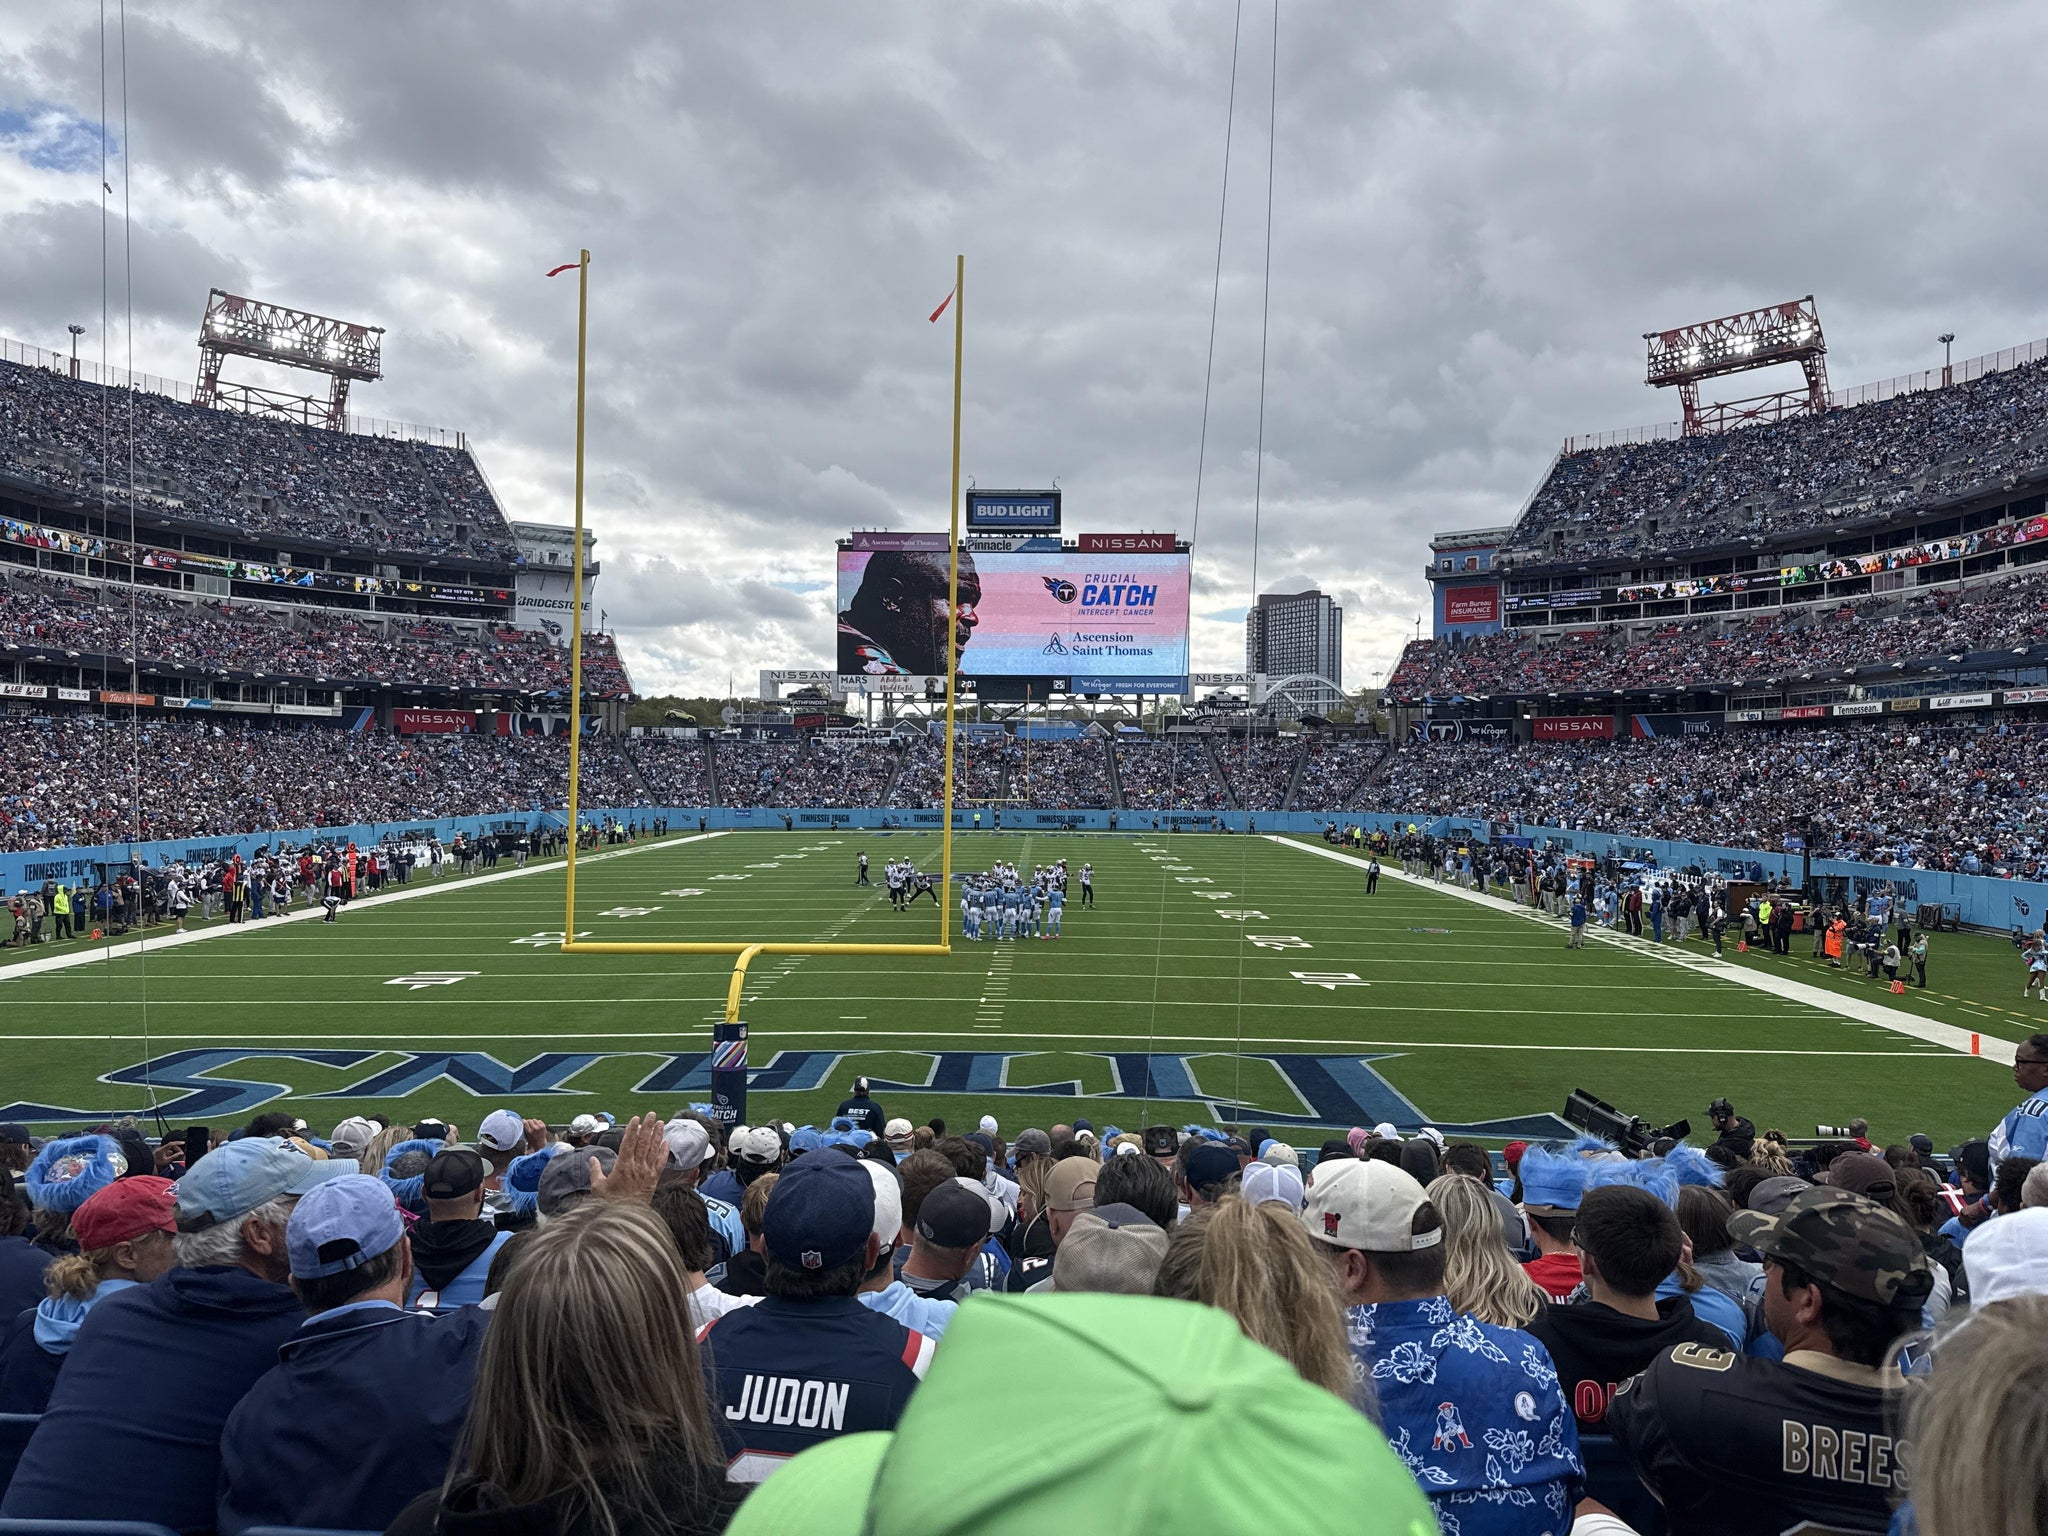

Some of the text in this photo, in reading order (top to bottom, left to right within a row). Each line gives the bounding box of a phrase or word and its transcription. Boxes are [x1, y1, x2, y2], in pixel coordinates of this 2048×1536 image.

[976, 505, 1050, 516] BUD LIGHT
[967, 539, 1012, 551] Pinnacle
[1091, 538, 1163, 548] NISSAN
[158, 555, 177, 564] CATCH
[1085, 574, 1138, 583] CRUCIAL
[1730, 578, 1749, 586] CATCH
[1081, 585, 1158, 606] CATCH
[517, 595, 591, 612] BRIDGESTOE
[1078, 608, 1154, 616] INTERCEPT CANCER
[1450, 607, 1491, 615] INSURANCE
[1072, 632, 1134, 643] Ascension
[1072, 645, 1153, 656] Saint Thomas
[770, 671, 831, 680] NISSAN
[840, 675, 868, 684] MARS
[1196, 674, 1256, 682] NISSAN
[961, 680, 977, 688] 2:07
[1053, 680, 1065, 689] 25
[1090, 678, 1113, 692] Kroger
[11, 685, 23, 693] LEE
[32, 687, 45, 695] LEE
[109, 693, 126, 702] Tito's
[1187, 708, 1204, 721] JACK
[1837, 705, 1879, 715] Tennessean.
[404, 713, 466, 725] NISSAN
[1746, 711, 1760, 720] tsu
[1480, 723, 1508, 738] Kroger
[1543, 721, 1603, 731] NISSAN
[1682, 720, 1710, 733] TITANS
[800, 814, 830, 823] TENNESSEE
[914, 814, 945, 823] TENNESSEE
[1036, 815, 1066, 824] TENNESSEE
[185, 848, 218, 864] TENNESSEE
[24, 859, 68, 882] TENNESSEE
[847, 1108, 871, 1116] BEST
[725, 1374, 850, 1431] JUDON
[1782, 1419, 1914, 1490] BREES
